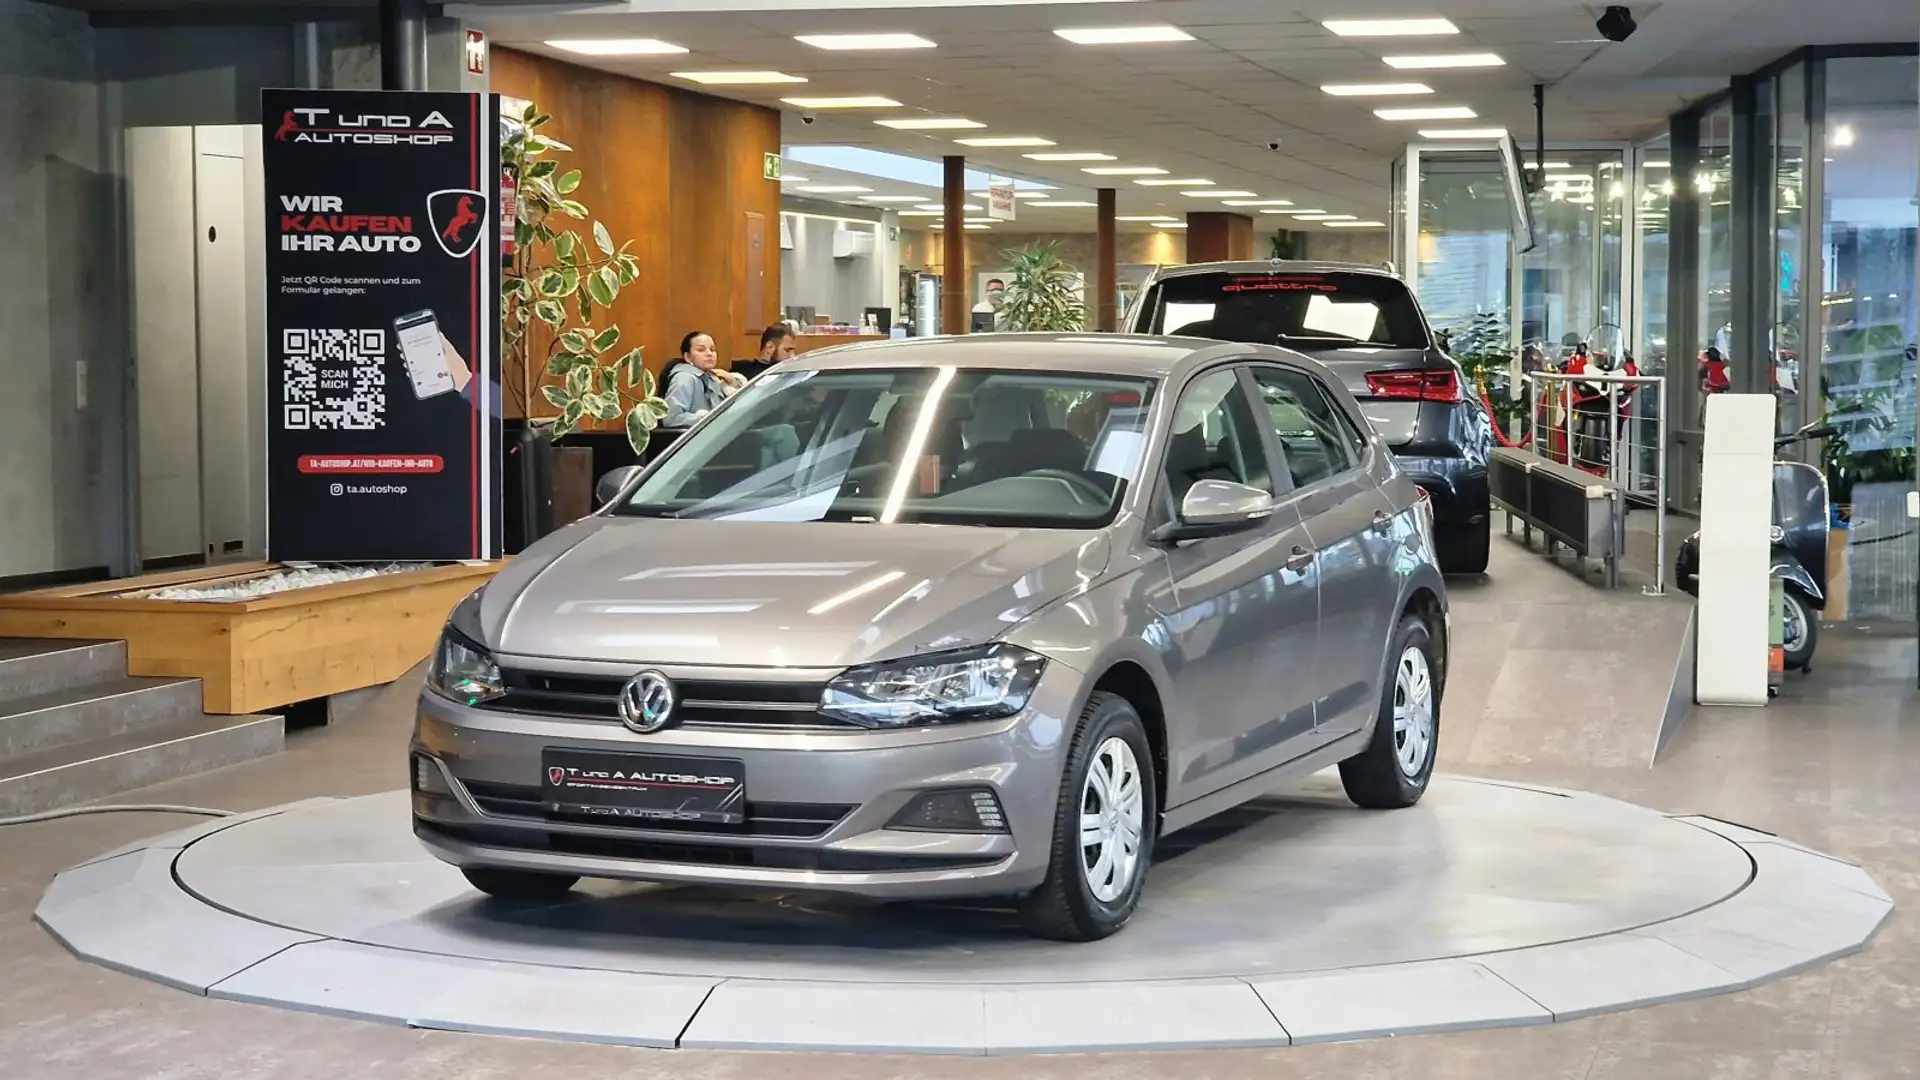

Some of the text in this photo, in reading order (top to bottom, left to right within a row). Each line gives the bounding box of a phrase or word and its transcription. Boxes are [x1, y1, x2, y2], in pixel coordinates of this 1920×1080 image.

[293, 108, 330, 126] T
[418, 110, 454, 128] A
[294, 133, 454, 145] AUTOSHOP
[280, 195, 343, 212] WIR
[280, 215, 413, 233] KAUFEN
[281, 235, 422, 253] IHR AUTO
[280, 275, 421, 286] Jetzt QR Code scannen und zum
[281, 285, 366, 296] Formular gelangen:
[1222, 283, 1338, 292] quattro
[321, 369, 349, 379] SCAN
[321, 379, 349, 389] MICH
[346, 484, 408, 495] ta.autoshop
[566, 768, 580, 776] T
[613, 771, 626, 779] A
[629, 771, 736, 785] AUTOSHOP
[623, 808, 703, 820] AUTOSHOP
